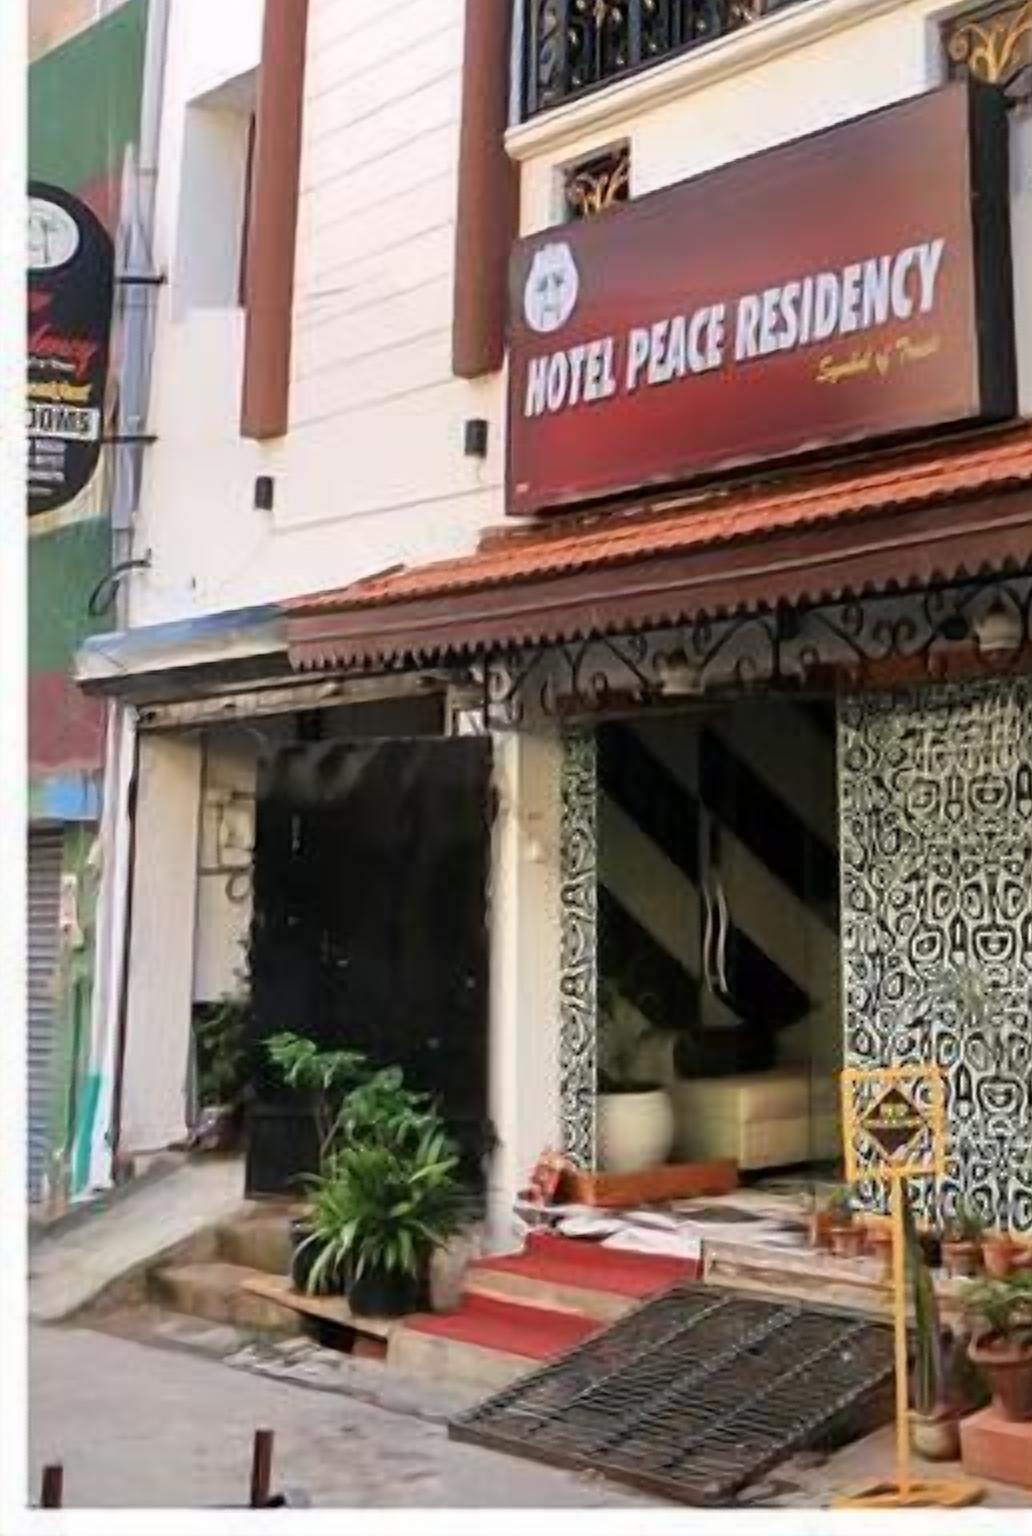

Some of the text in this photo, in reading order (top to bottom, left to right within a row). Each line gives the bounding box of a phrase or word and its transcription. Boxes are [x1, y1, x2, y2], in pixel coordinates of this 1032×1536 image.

[523, 237, 946, 418] HOTEL PEACE RESIDENCY
